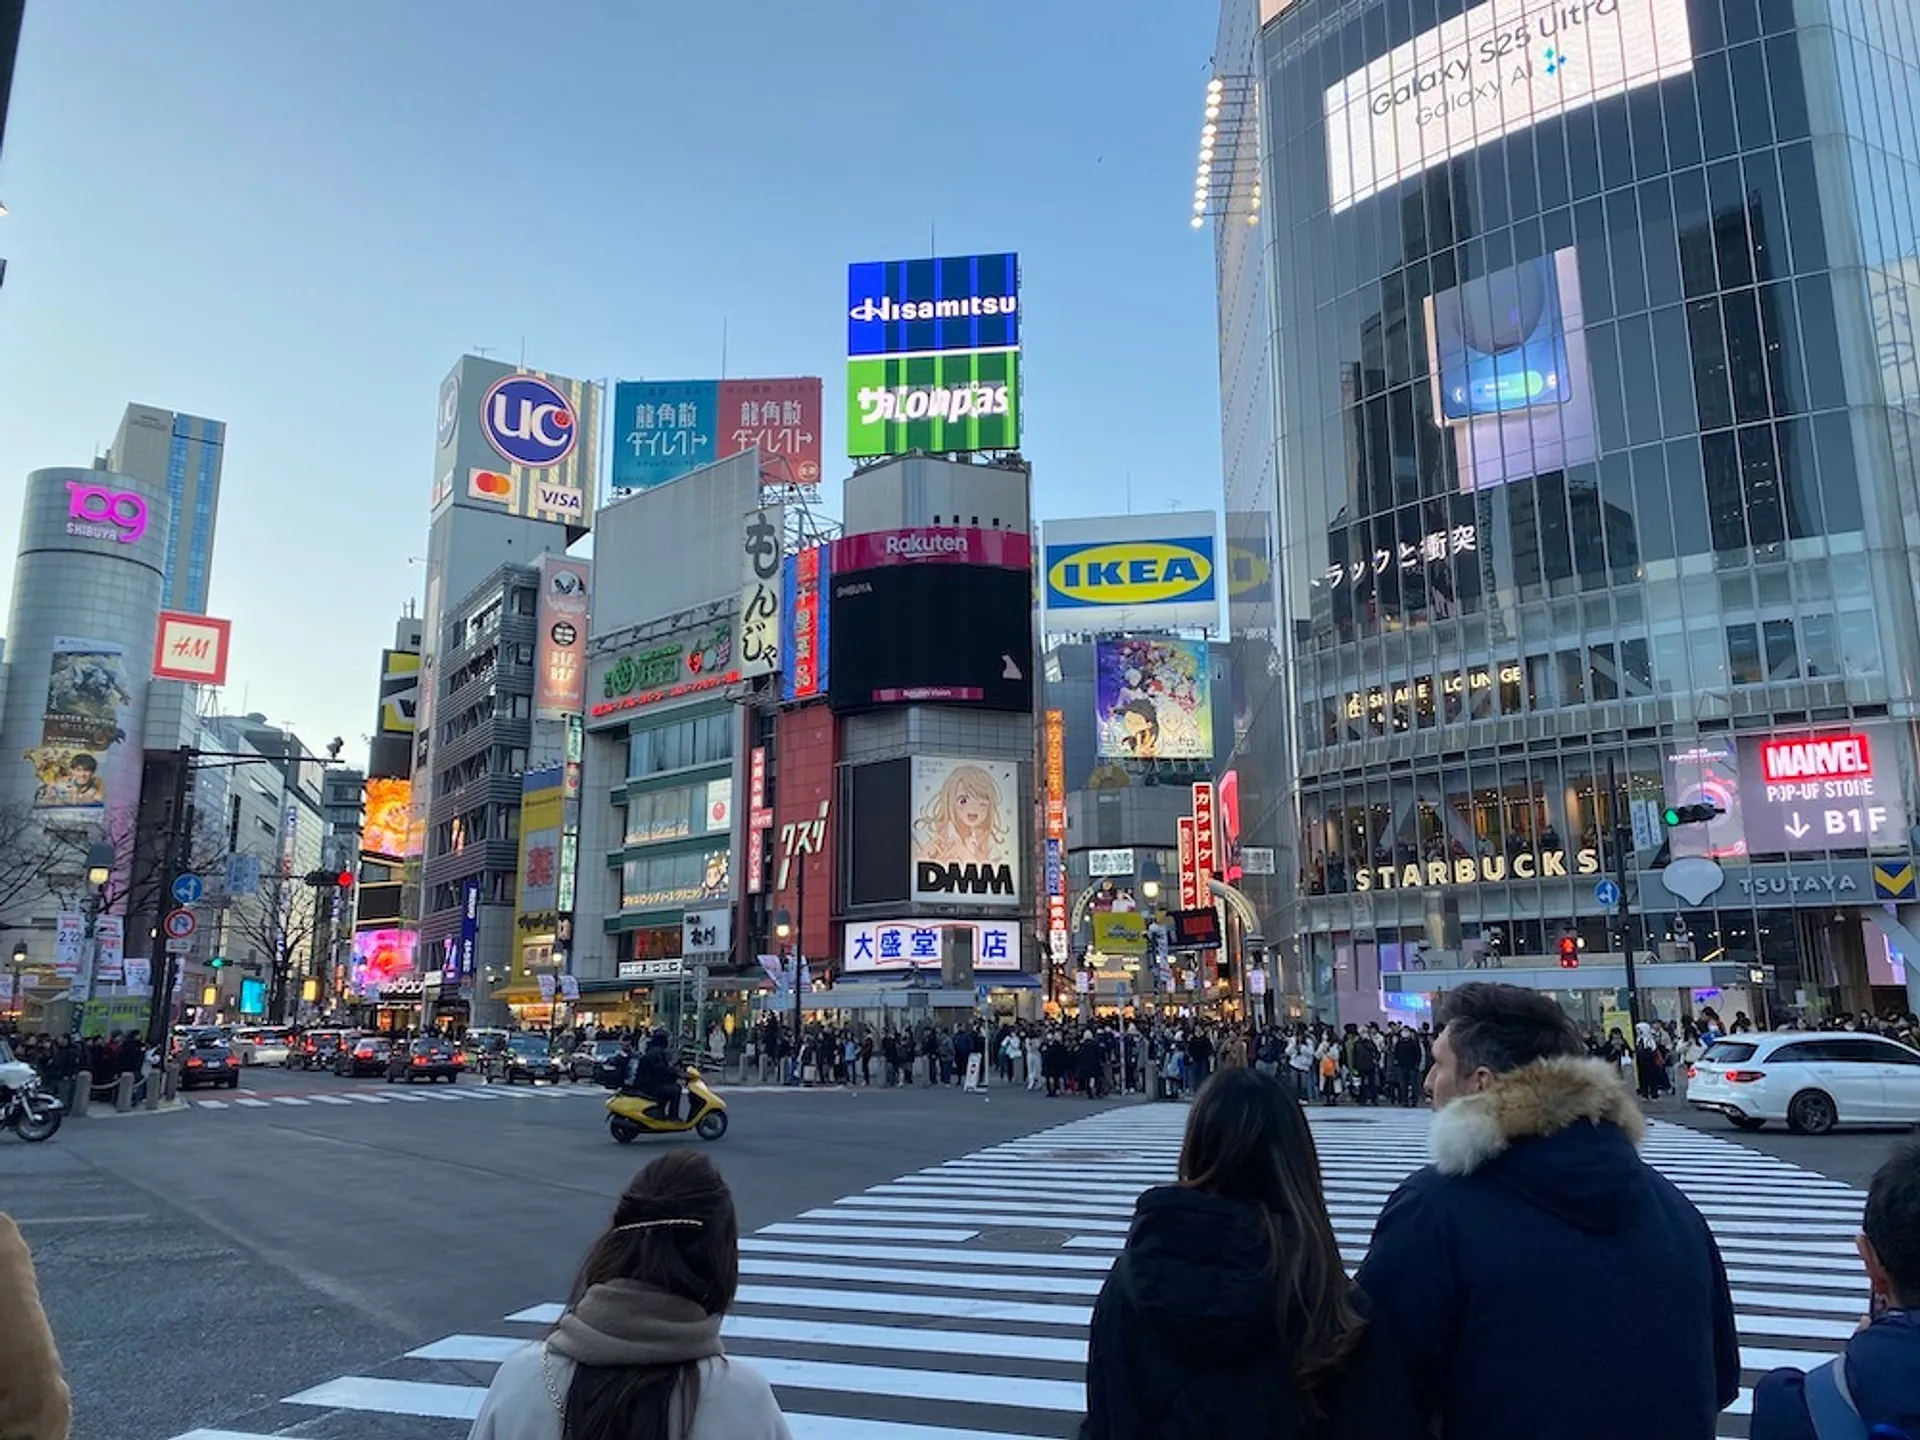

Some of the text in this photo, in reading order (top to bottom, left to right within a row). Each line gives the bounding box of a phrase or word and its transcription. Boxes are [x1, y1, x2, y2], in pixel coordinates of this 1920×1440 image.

[1371, 54, 1472, 116] Galaxy
[1480, 25, 1531, 65] S25
[1416, 77, 1500, 127] Galaxy
[850, 296, 1016, 322] Hisamitsu
[635, 402, 698, 429] 龍角散
[741, 400, 802, 428] 龍角散
[66, 481, 149, 544] 109
[541, 488, 581, 510] VISA
[66, 521, 118, 542] SHIBUYA
[886, 535, 968, 555] Rakuten
[1063, 556, 1201, 588] IKEA
[744, 512, 780, 669] もんじゃ
[171, 636, 209, 660] H&M
[1766, 739, 1868, 778] MARVEL
[1766, 778, 1874, 802] POP-UP STORE
[1825, 807, 1887, 834] B1F
[917, 861, 1015, 895] DMM
[1355, 849, 1599, 891] STARBUCKS
[1739, 874, 1857, 895] TSUTAYA
[854, 928, 1008, 960] 大盛堂店
